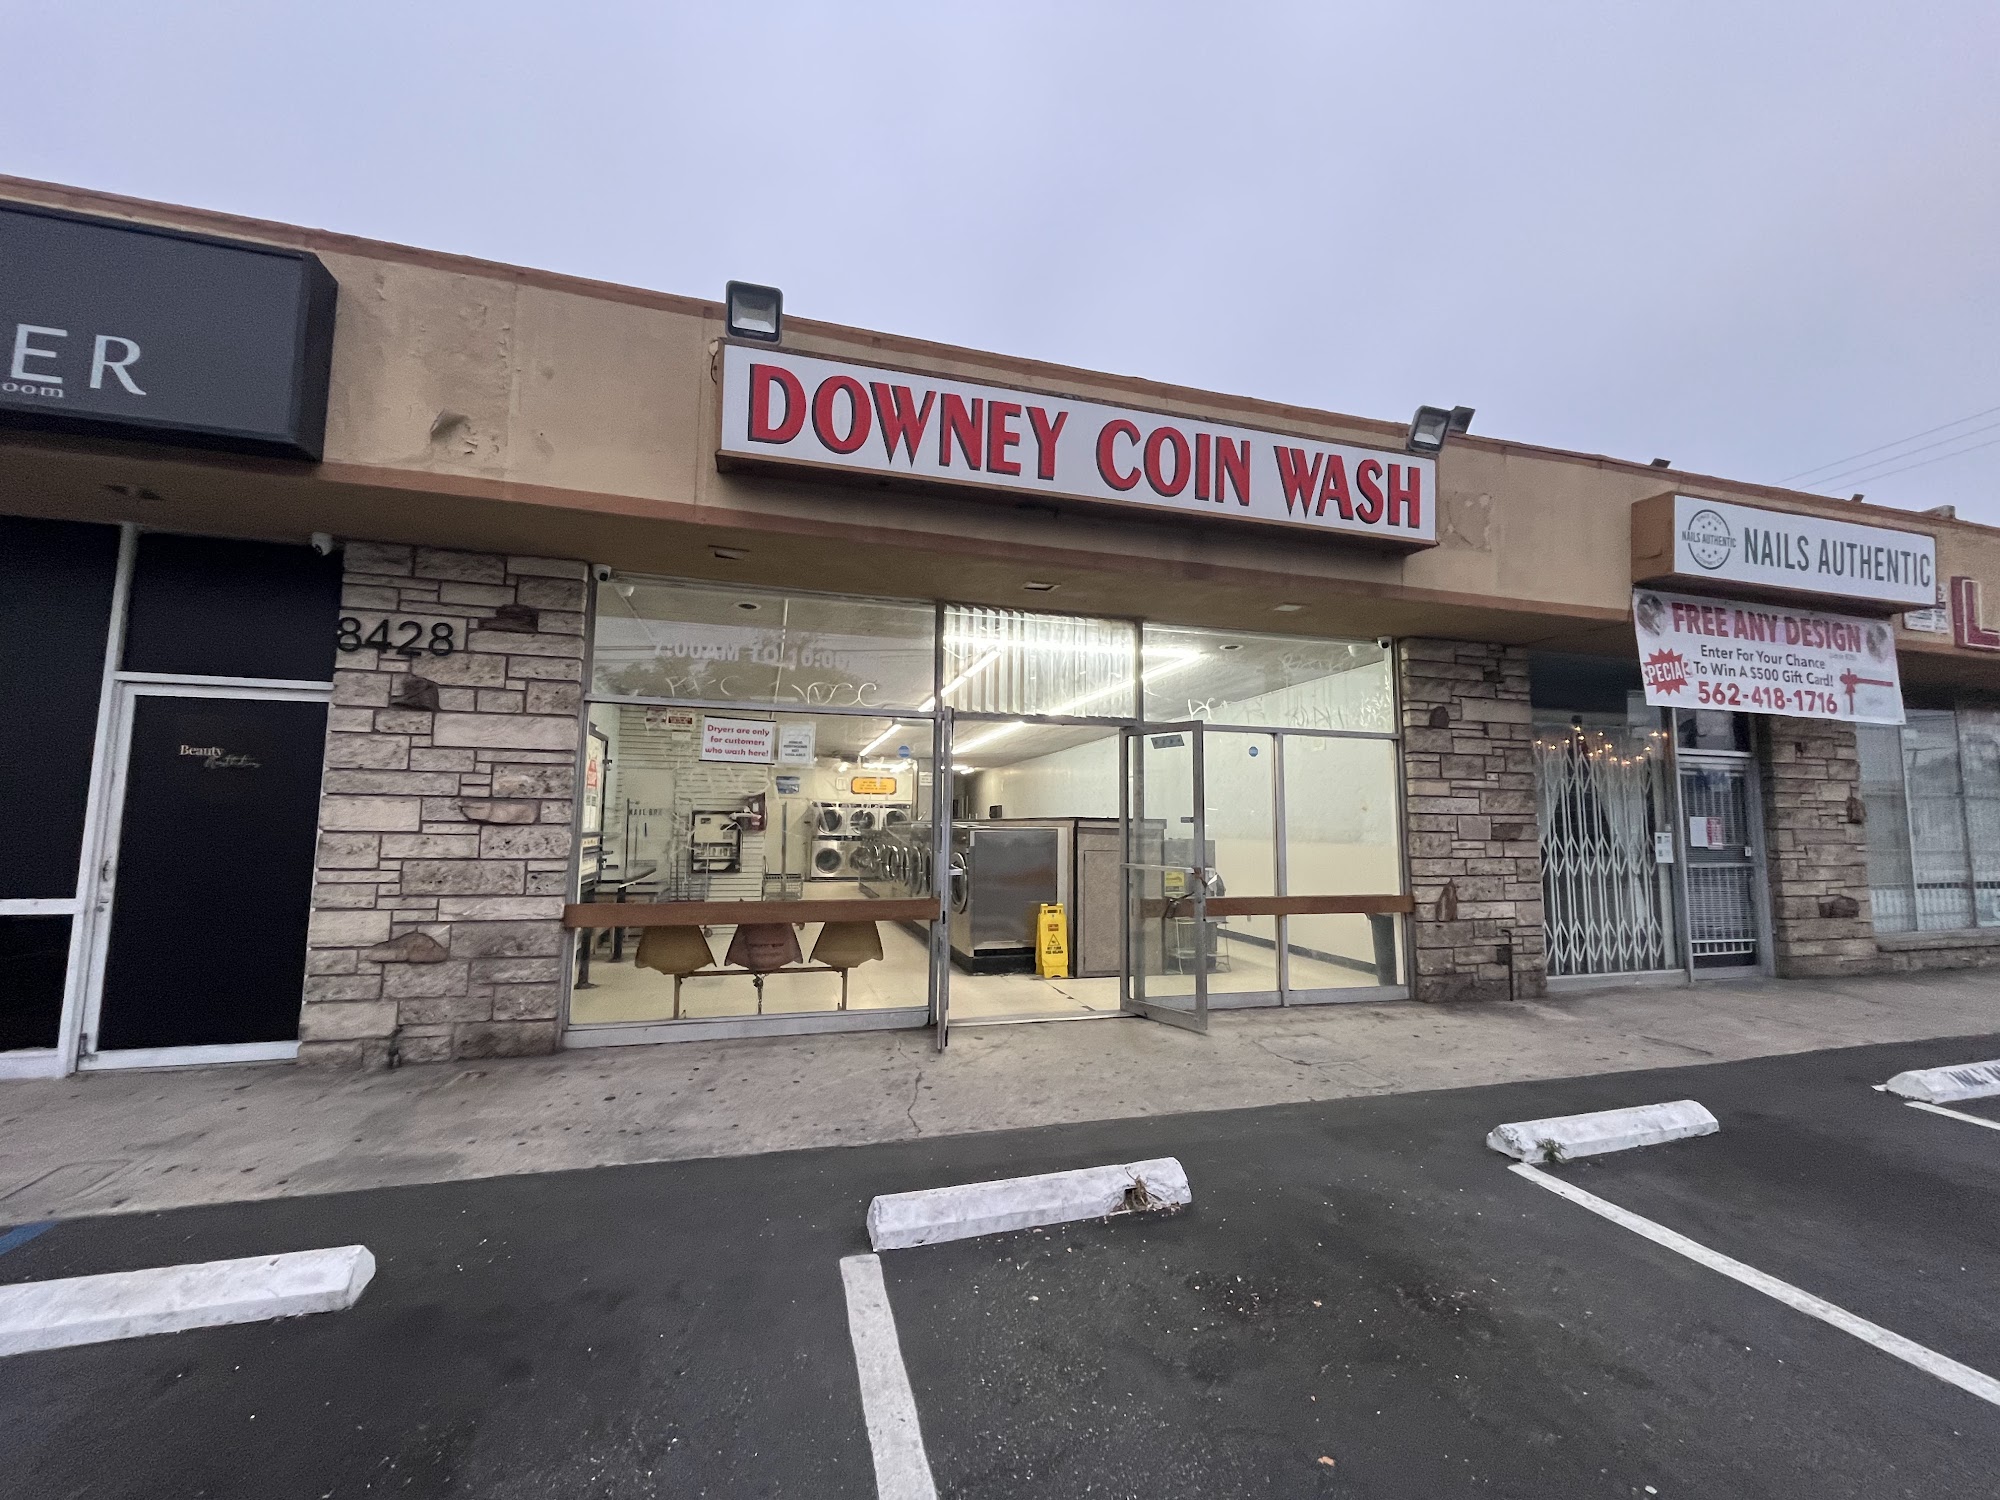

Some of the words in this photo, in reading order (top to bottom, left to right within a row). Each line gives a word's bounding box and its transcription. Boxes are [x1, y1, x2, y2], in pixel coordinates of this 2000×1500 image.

[10, 323, 147, 396] ER
[748, 363, 1069, 481] DOWNEY
[1095, 419, 1251, 507] COIN
[1273, 445, 1420, 529] WASH
[1681, 530, 1701, 543] NAILS
[1701, 533, 1737, 549] AUTHENTIC
[1744, 527, 1809, 572] NAILS
[1818, 538, 1931, 588] AUTHENTIC
[337, 616, 454, 657] 8428
[1672, 602, 1729, 637] FREE
[1734, 609, 1777, 643] ANY
[1784, 616, 1861, 653] DESIGN
[1701, 644, 1733, 660] Enter
[1737, 648, 1754, 662] For
[1756, 650, 1782, 665] Your
[1786, 654, 1826, 669] Chance
[1641, 660, 1693, 686] SPECIAL
[1693, 661, 1707, 675] To
[1710, 662, 1736, 677] Win
[1740, 665, 1758, 678] A
[1782, 670, 1803, 683] Gift
[1806, 672, 1834, 687] Card!
[1698, 681, 1838, 714] 562-418-1716
[707, 724, 735, 734] Dryers
[752, 728, 770, 737] only
[710, 735, 723, 743] for
[724, 738, 765, 746] customers
[180, 744, 224, 757] Beauty
[724, 748, 746, 756] wash
[748, 749, 769, 757] here!
